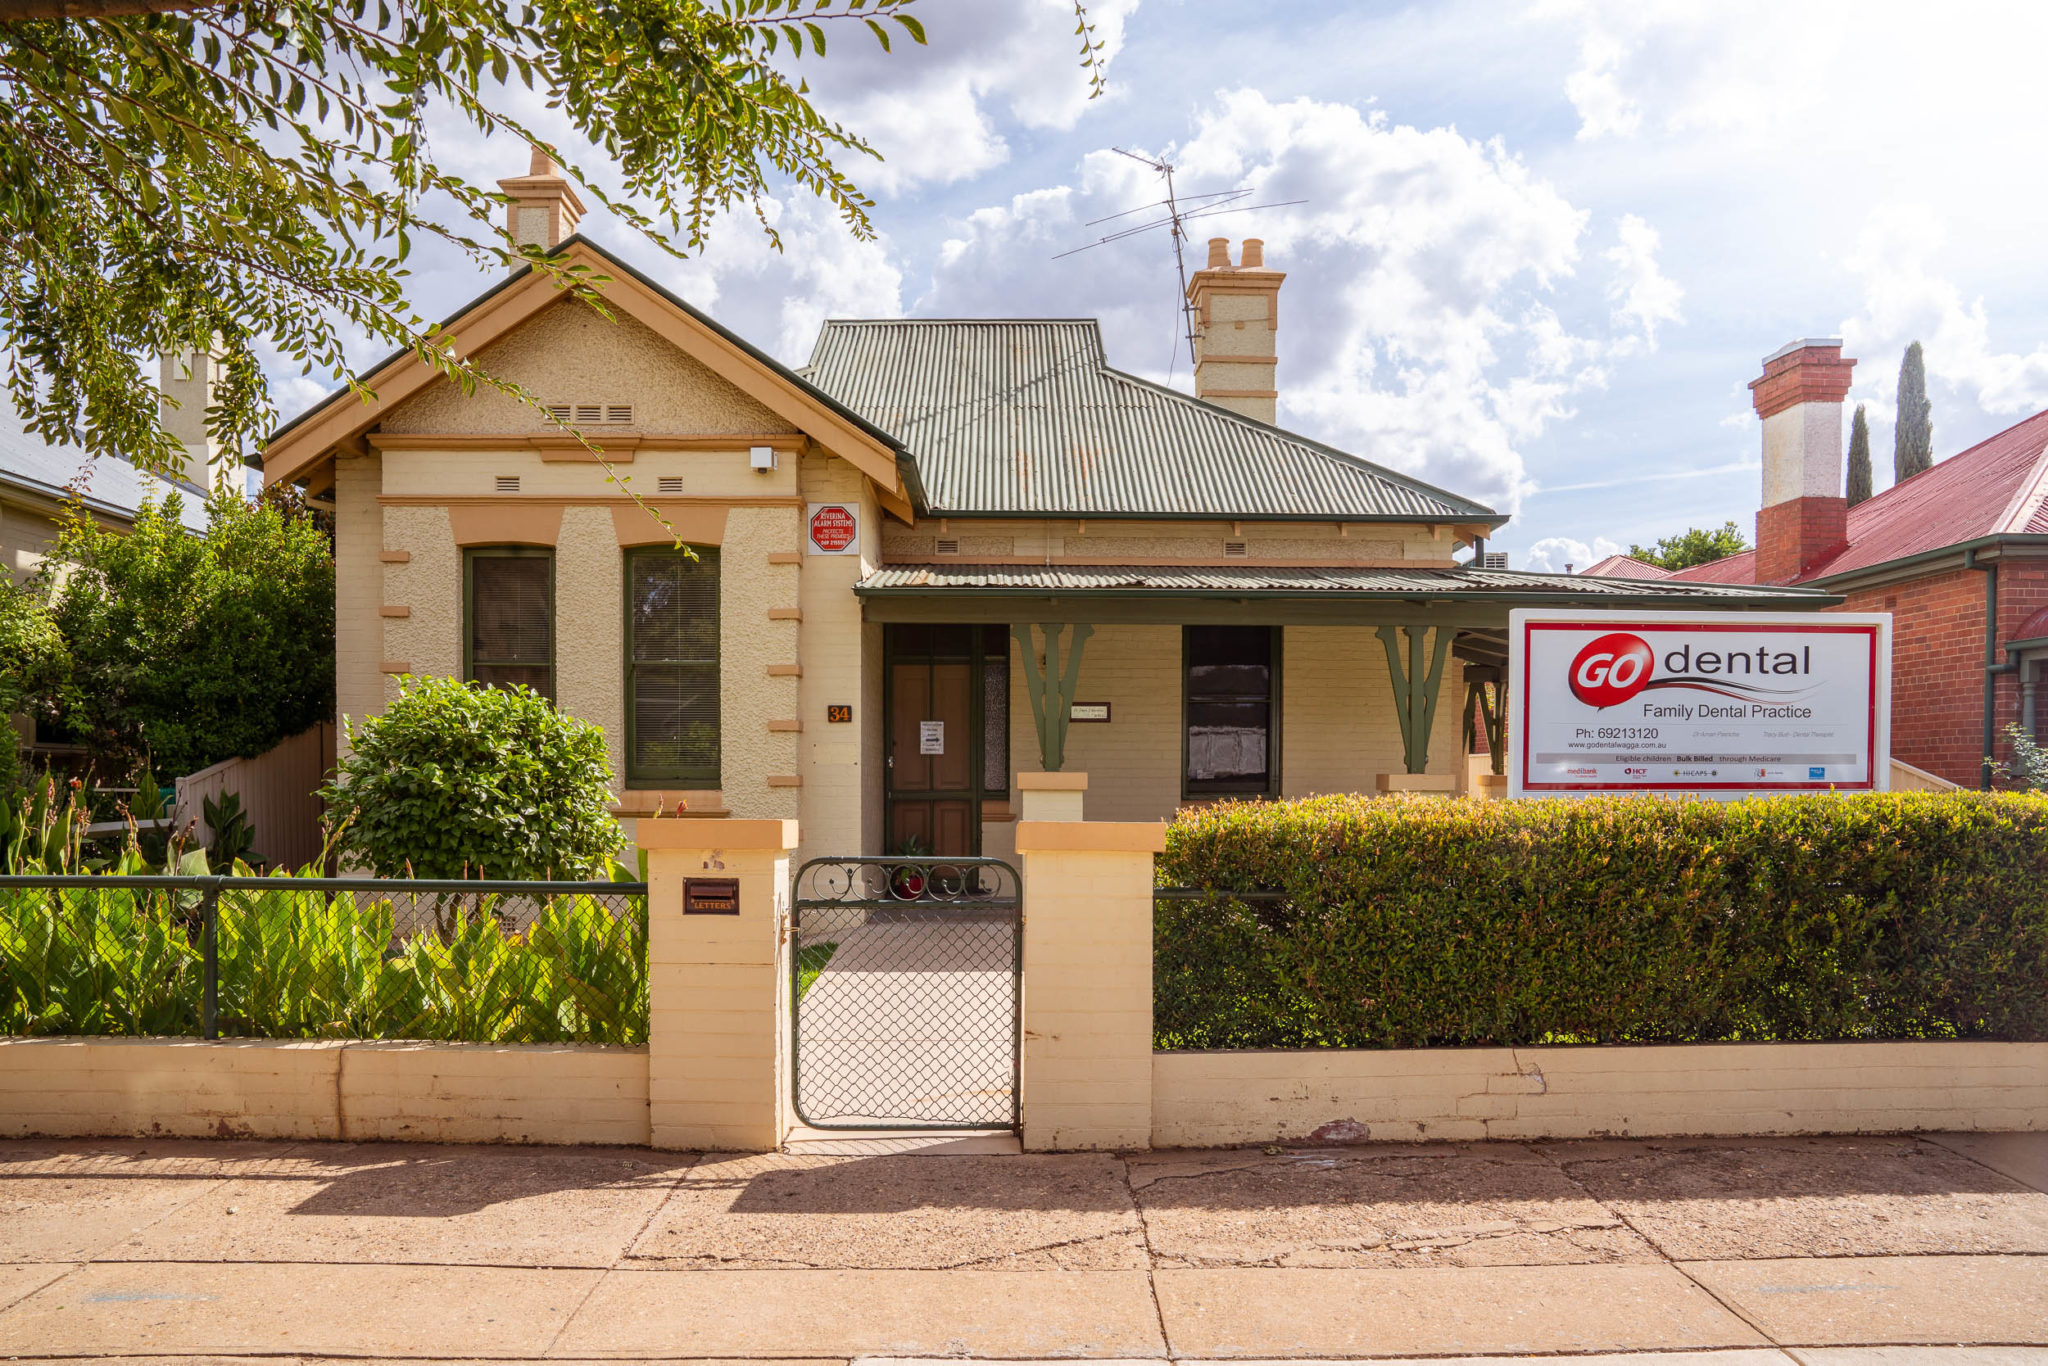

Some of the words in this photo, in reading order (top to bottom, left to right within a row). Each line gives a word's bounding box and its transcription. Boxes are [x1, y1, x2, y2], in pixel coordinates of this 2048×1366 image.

[1577, 652, 1644, 688] GO
[1664, 644, 1810, 675] dental
[830, 706, 849, 721] 34
[1643, 704, 1693, 721] Family
[1699, 704, 1747, 719] Dental
[1752, 704, 1812, 719] Practice
[1576, 728, 1594, 739] Ph:
[1598, 728, 1659, 739] 69213120
[1568, 741, 1667, 750] www.godentalwagga.com.au
[1616, 755, 1642, 764] Eligible
[1643, 755, 1671, 763] children
[1676, 755, 1692, 763] Bulk
[1694, 755, 1713, 763] Billed
[1720, 755, 1747, 764] through
[1749, 755, 1781, 763] Medicare
[1567, 767, 1597, 775] medibank
